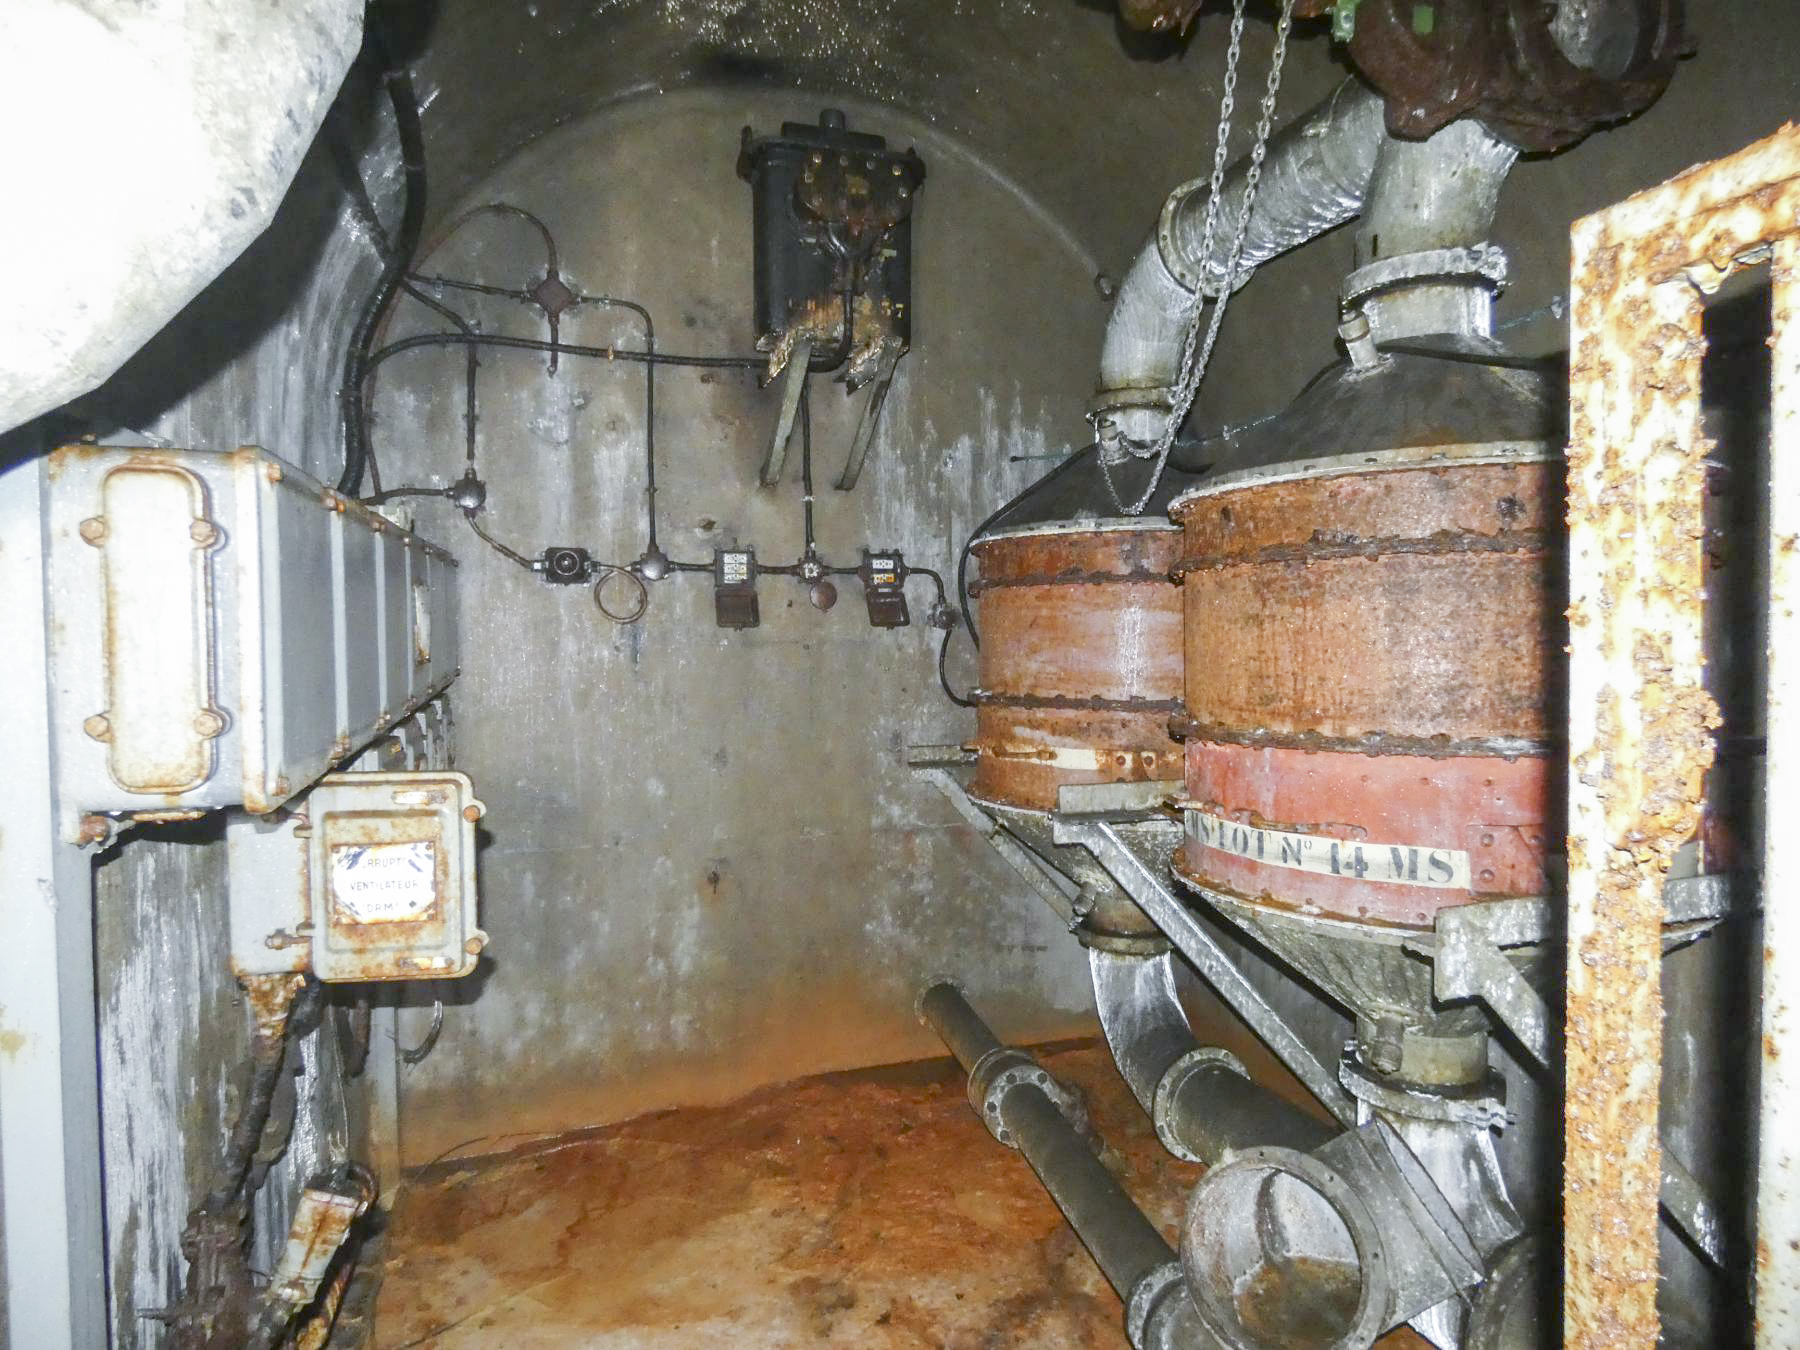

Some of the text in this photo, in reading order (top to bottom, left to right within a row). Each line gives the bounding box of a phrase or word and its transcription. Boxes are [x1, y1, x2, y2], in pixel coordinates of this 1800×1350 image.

[1329, 842, 1369, 879] 14
[1388, 846, 1454, 883] MS
[350, 879, 418, 891] VENTILATEUR
